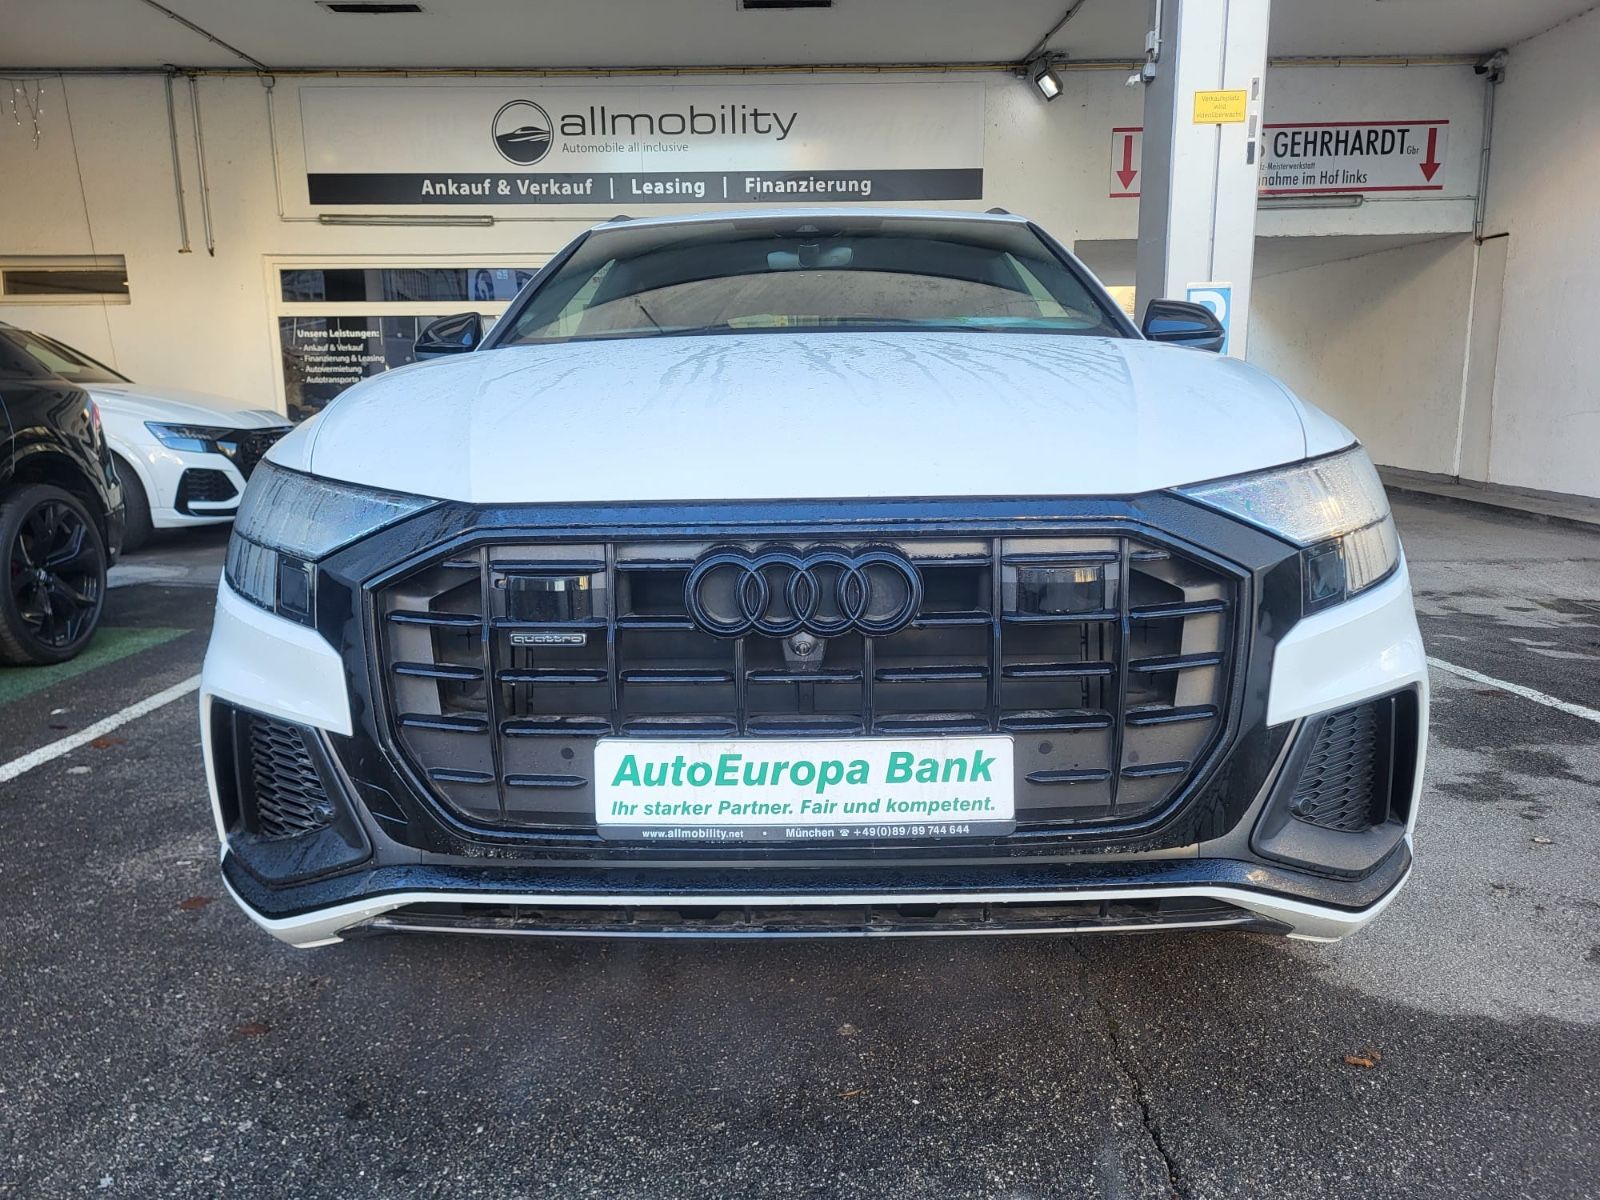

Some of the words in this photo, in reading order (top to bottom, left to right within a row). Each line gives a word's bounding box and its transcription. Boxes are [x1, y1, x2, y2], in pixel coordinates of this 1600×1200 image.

[560, 104, 798, 141] allmobility
[562, 143, 625, 153] Automobile
[627, 142, 640, 152] all
[643, 142, 689, 152] inclusive
[1273, 128, 1410, 158] GEHRHARDT
[1302, 171, 1316, 185] im
[1319, 170, 1340, 185] Hof
[1342, 168, 1368, 184] links
[421, 178, 491, 196] Ankauf
[496, 178, 511, 196] &
[516, 178, 593, 196] Verkauf
[631, 177, 705, 198] Leasing
[745, 176, 872, 196] Finanzierung
[296, 329, 328, 338] Unsere
[328, 328, 380, 339] Leistungen:
[303, 343, 328, 351] Ankauf
[336, 343, 364, 351] Verkauf
[304, 354, 350, 363] Finanzierung
[358, 354, 385, 363] Leasing
[305, 365, 362, 374] Autovermietung
[514, 635, 583, 644] quattro
[611, 752, 870, 794] AutoEuropa
[885, 750, 996, 784] Bank
[611, 801, 638, 816] Ihr
[643, 801, 712, 816] starker
[718, 800, 793, 815] Partner.
[800, 799, 838, 815] Fair
[843, 798, 880, 814] und
[885, 796, 996, 815] kompetent.
[642, 828, 744, 839] www.allmobility.net
[785, 827, 834, 838] München
[853, 825, 926, 836] +49(0)89/89
[927, 825, 947, 835] 744
[949, 825, 970, 834] 644
